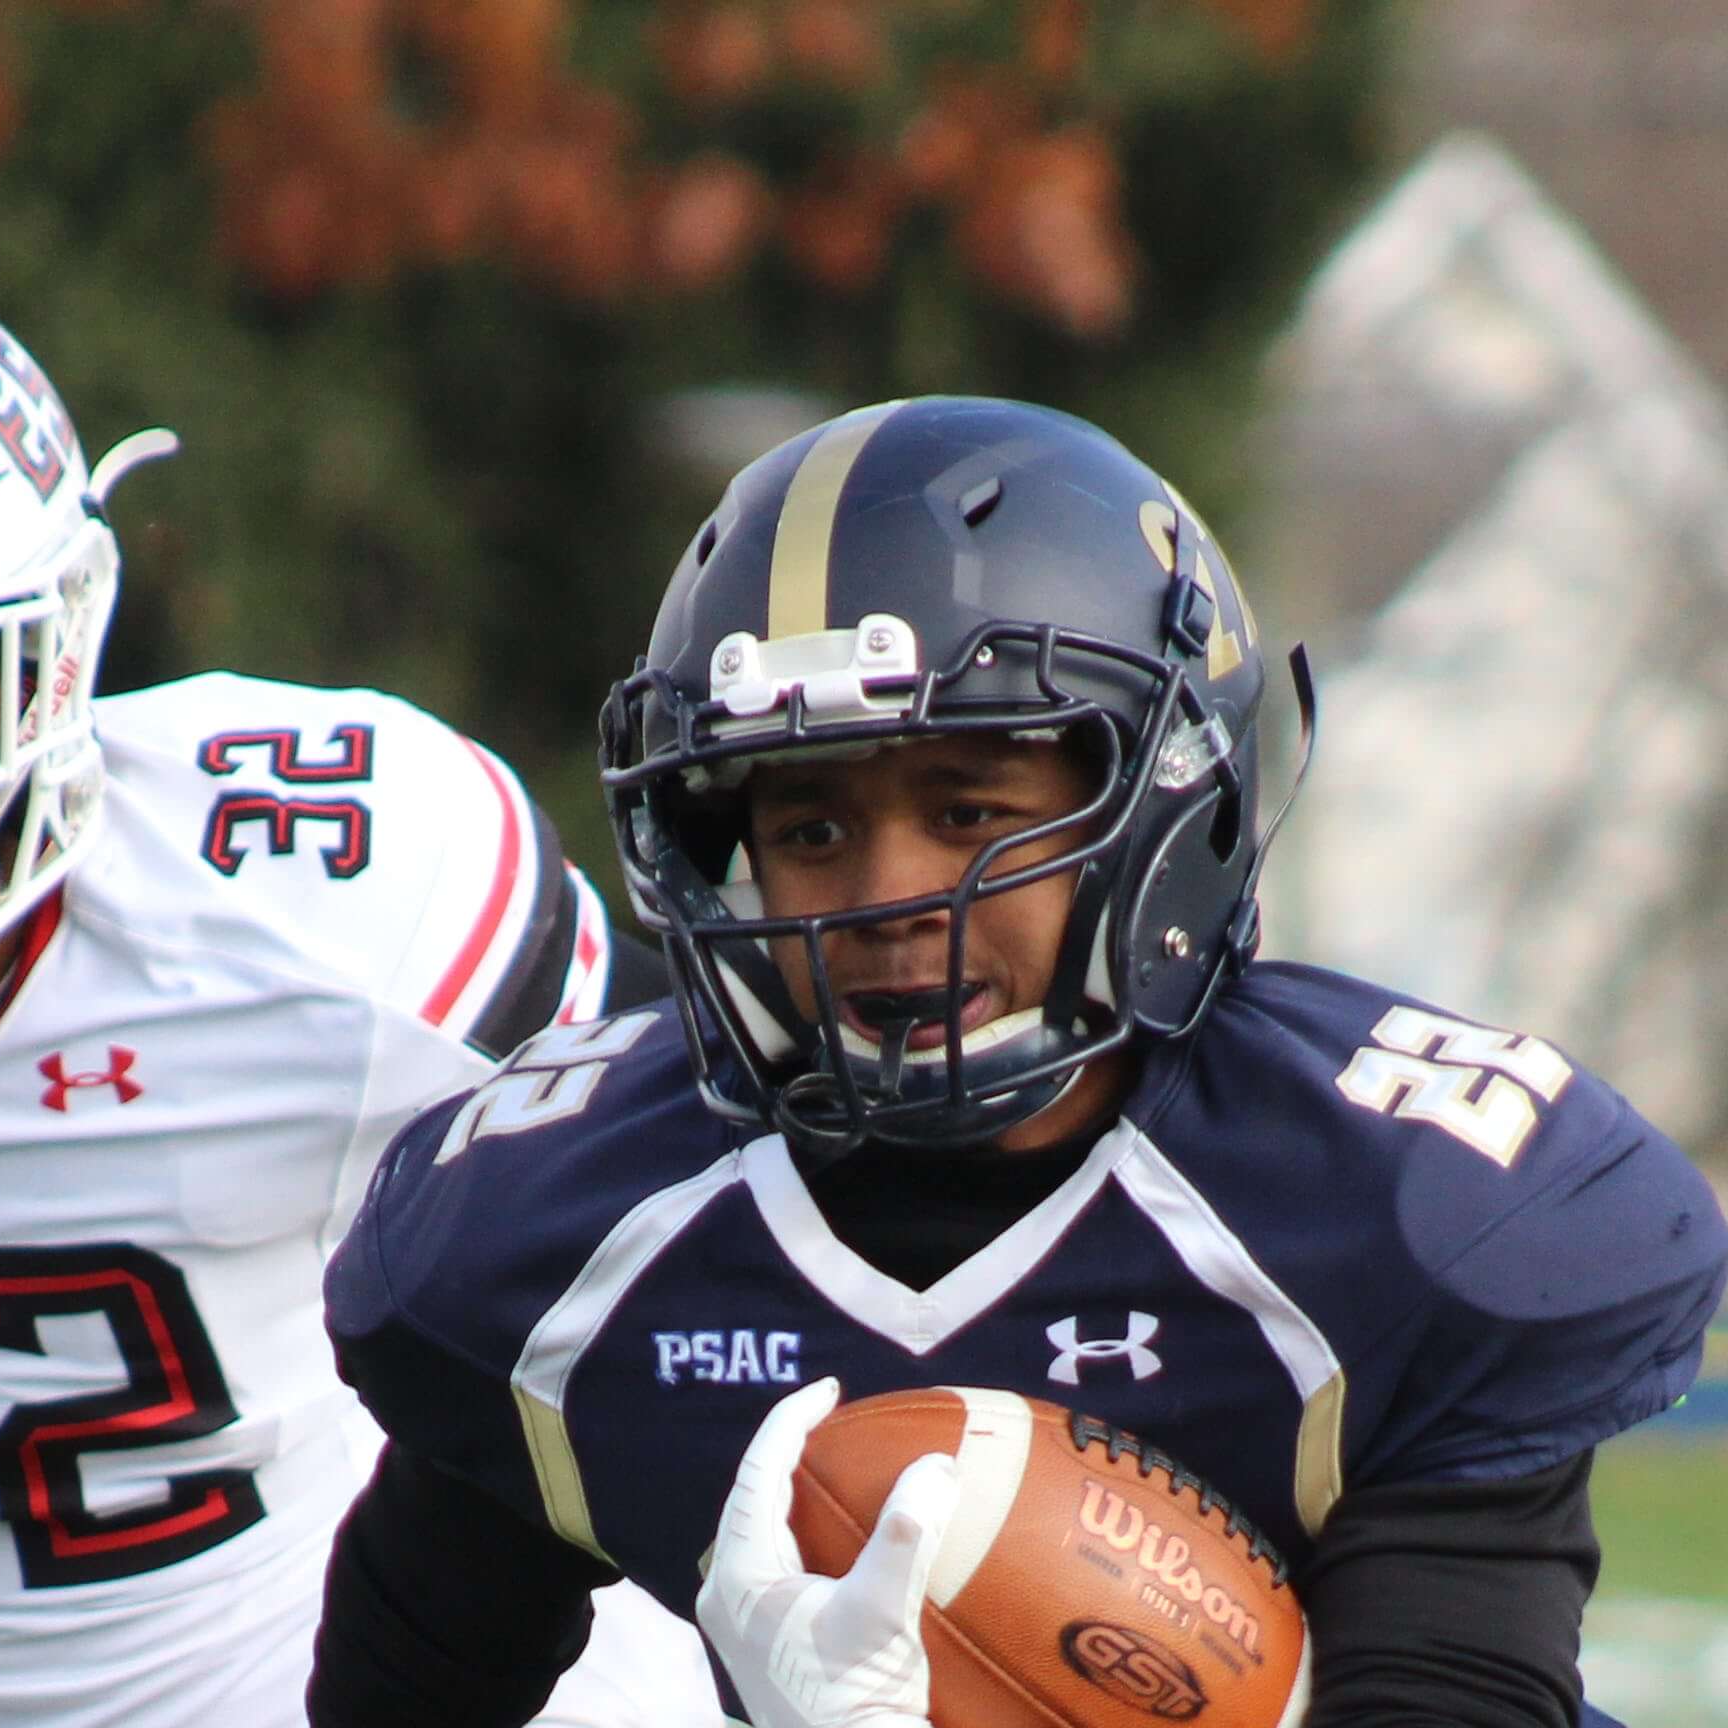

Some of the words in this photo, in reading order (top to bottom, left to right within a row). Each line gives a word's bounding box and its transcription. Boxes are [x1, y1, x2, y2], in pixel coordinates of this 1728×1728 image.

[199, 723, 375, 880] 32
[1335, 1004, 1573, 1168] 22
[651, 1329, 802, 1384] PSAC
[1078, 1478, 1260, 1662] Wilson
[1075, 1625, 1204, 1712] GST
